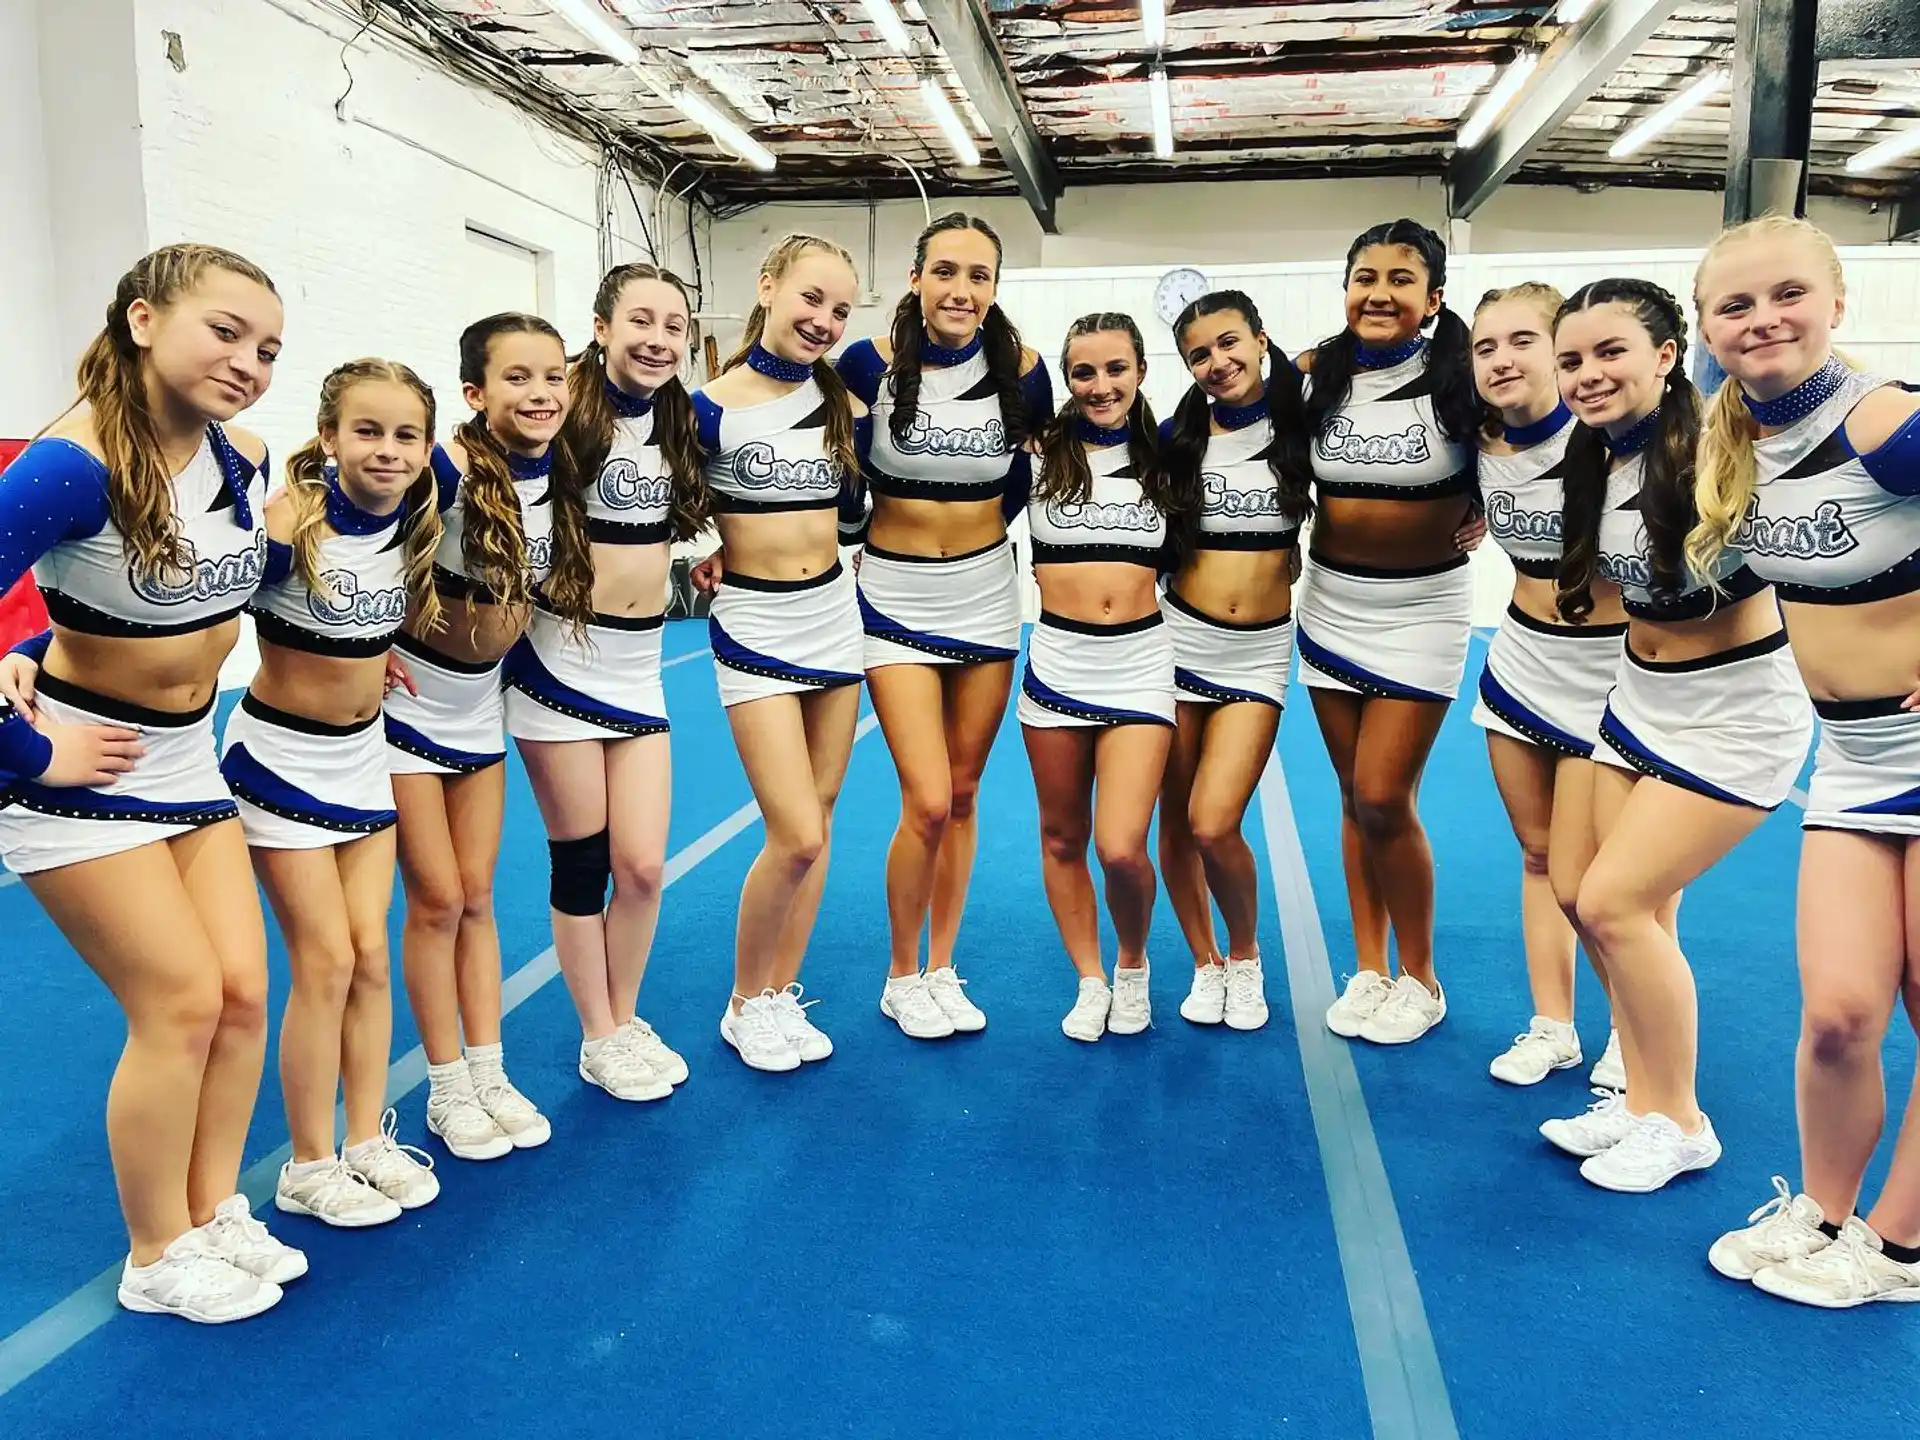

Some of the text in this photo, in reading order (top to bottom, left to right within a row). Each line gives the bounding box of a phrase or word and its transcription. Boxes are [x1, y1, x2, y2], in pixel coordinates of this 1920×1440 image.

[1315, 415, 1431, 465] Coast
[598, 458, 672, 510] Coa
[1200, 472, 1282, 518] Coas
[1487, 490, 1563, 541] Coas
[307, 569, 407, 626] Coas
